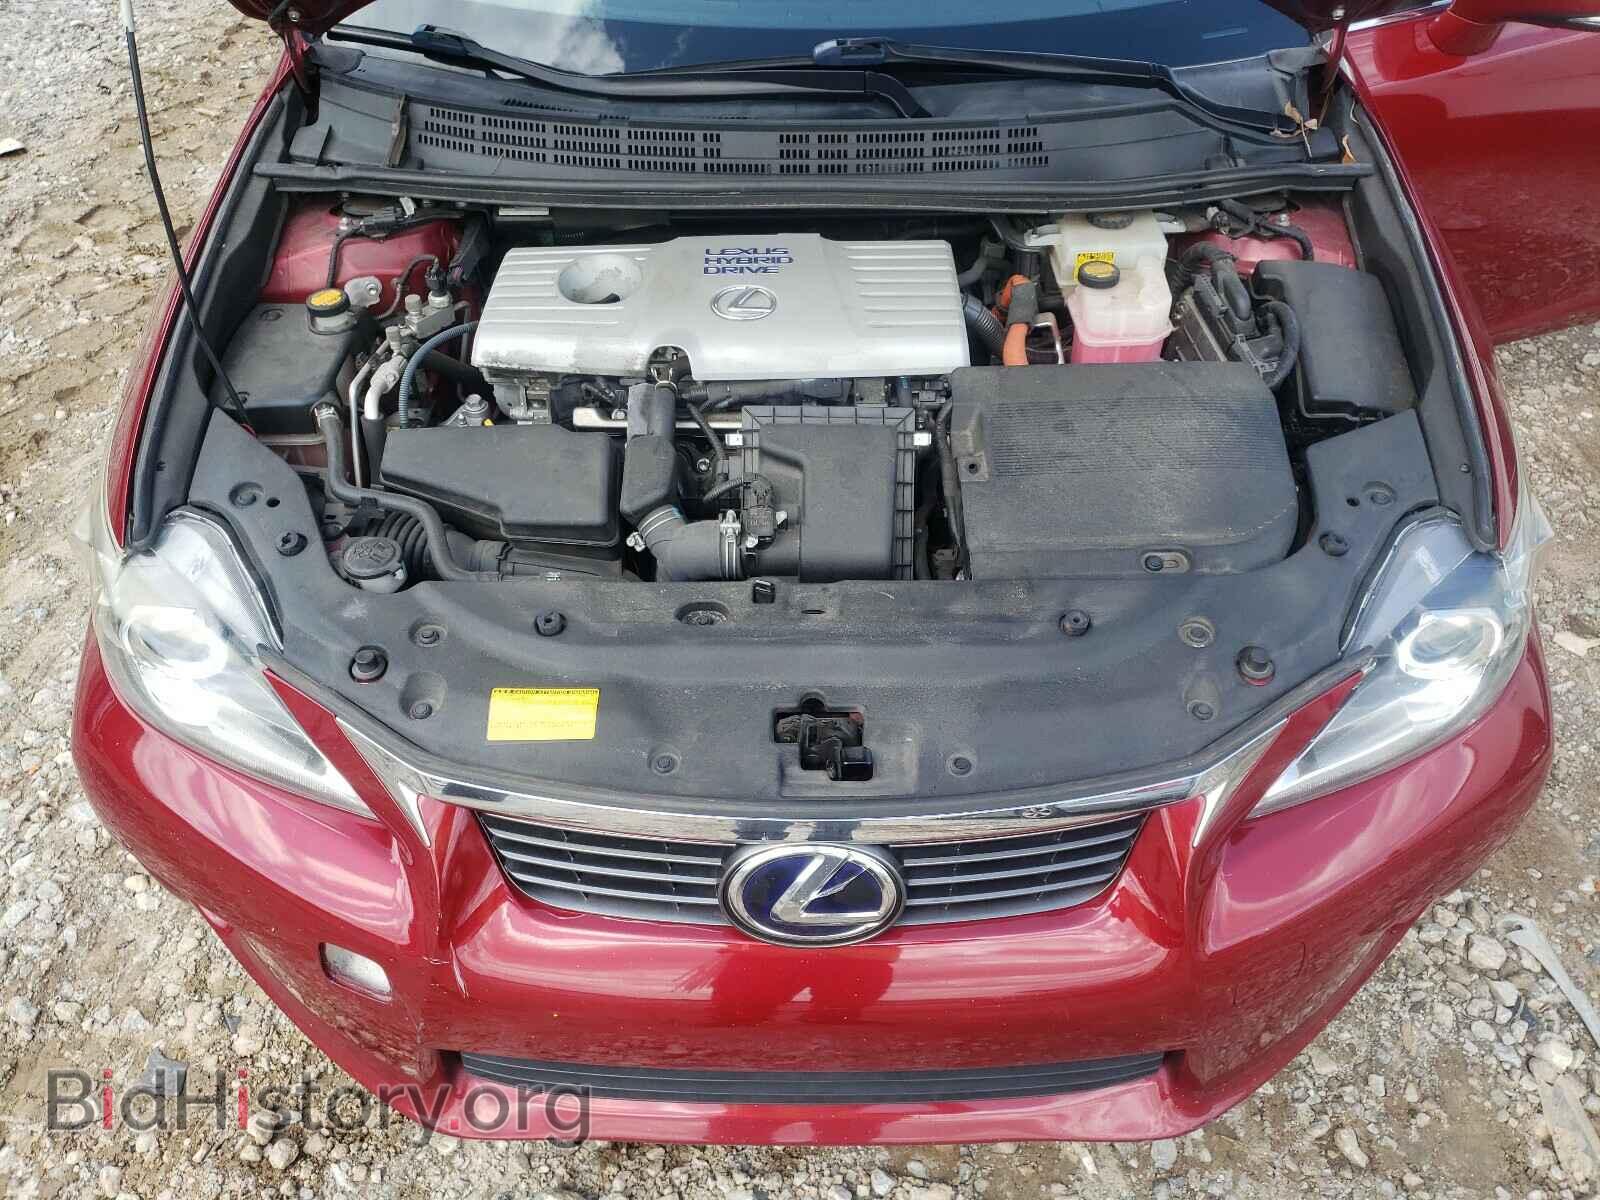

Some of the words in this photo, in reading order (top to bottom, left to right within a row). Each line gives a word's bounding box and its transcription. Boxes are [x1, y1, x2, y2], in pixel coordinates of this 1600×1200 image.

[705, 247, 789, 255] LEXUS
[704, 256, 794, 264] HYBRID
[703, 266, 779, 274] DRIVE
